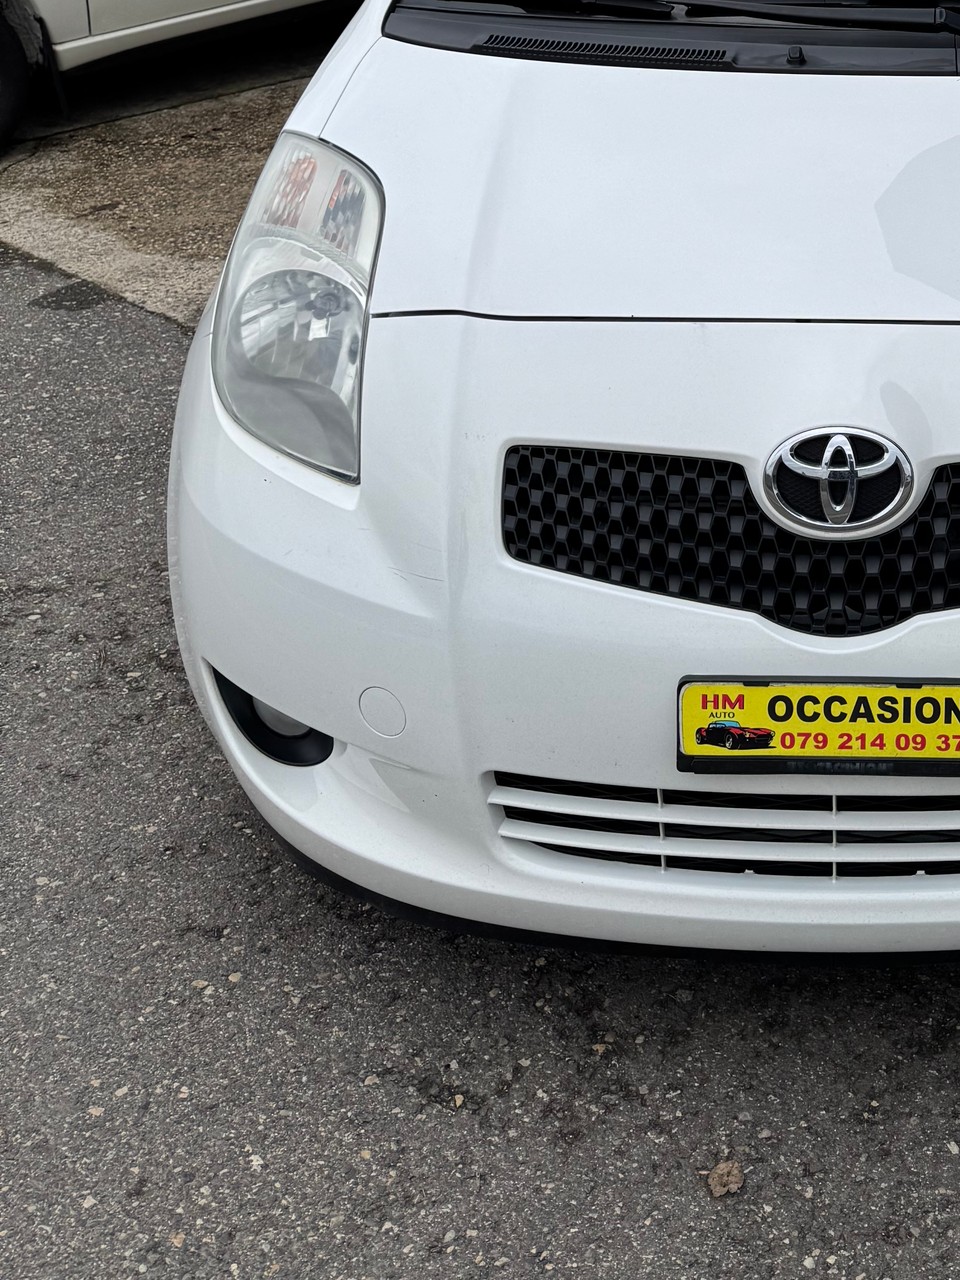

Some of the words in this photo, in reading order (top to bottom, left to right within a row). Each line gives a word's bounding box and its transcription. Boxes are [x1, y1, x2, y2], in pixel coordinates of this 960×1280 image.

[700, 693, 745, 710] HM
[708, 711, 735, 719] AUTO
[780, 732, 828, 751] 079
[837, 733, 886, 750] 214
[895, 733, 927, 752] 09
